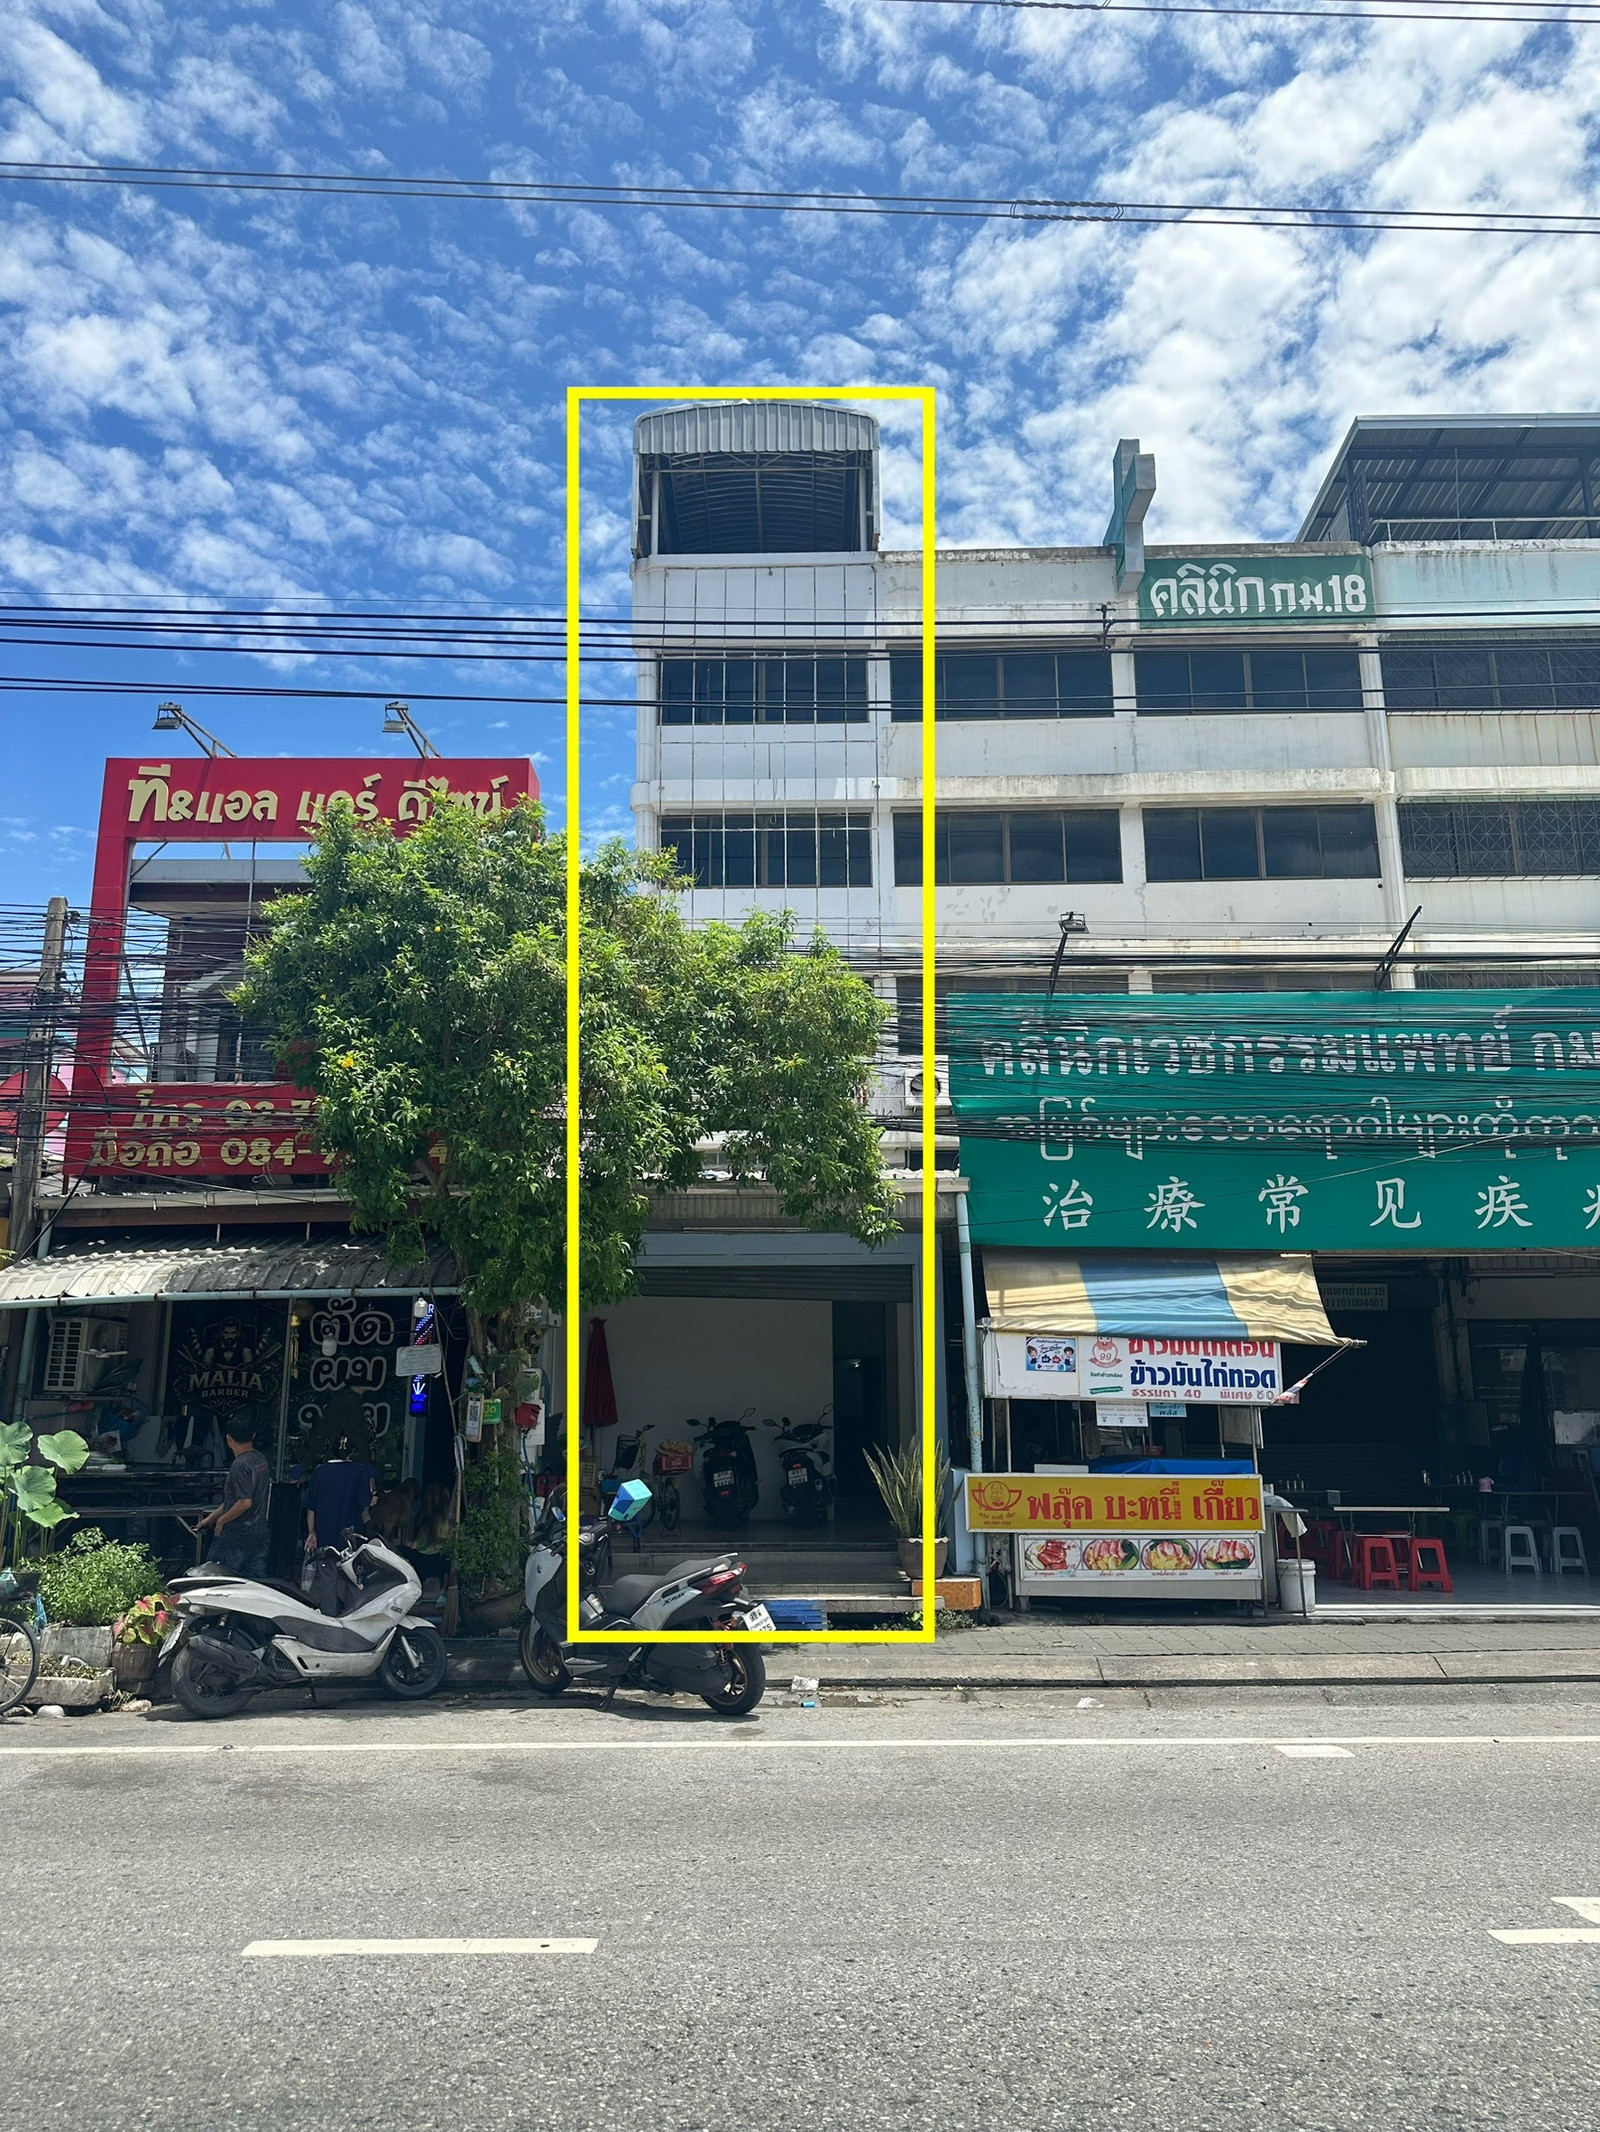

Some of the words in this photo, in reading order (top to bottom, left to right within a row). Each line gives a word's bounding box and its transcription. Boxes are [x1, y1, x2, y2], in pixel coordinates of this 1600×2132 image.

[1150, 563, 1265, 617] คลินิก
[1270, 574, 1367, 614] กม.18
[310, 1297, 394, 1345] ตัด
[187, 1370, 265, 1393] MALIA
[1130, 1358, 1277, 1389] ข้าวมันไก่ทอด
[201, 1388, 249, 1398] BARBER
[1132, 1388, 1177, 1399] ธรรมดา
[1184, 1388, 1201, 1399] 40
[1220, 1387, 1253, 1400] พิเศษ
[1026, 1487, 1094, 1529] ฟลุ๊ค
[1104, 1481, 1182, 1520] บะหมี่
[1193, 1479, 1260, 1521] เกี๊ยว
